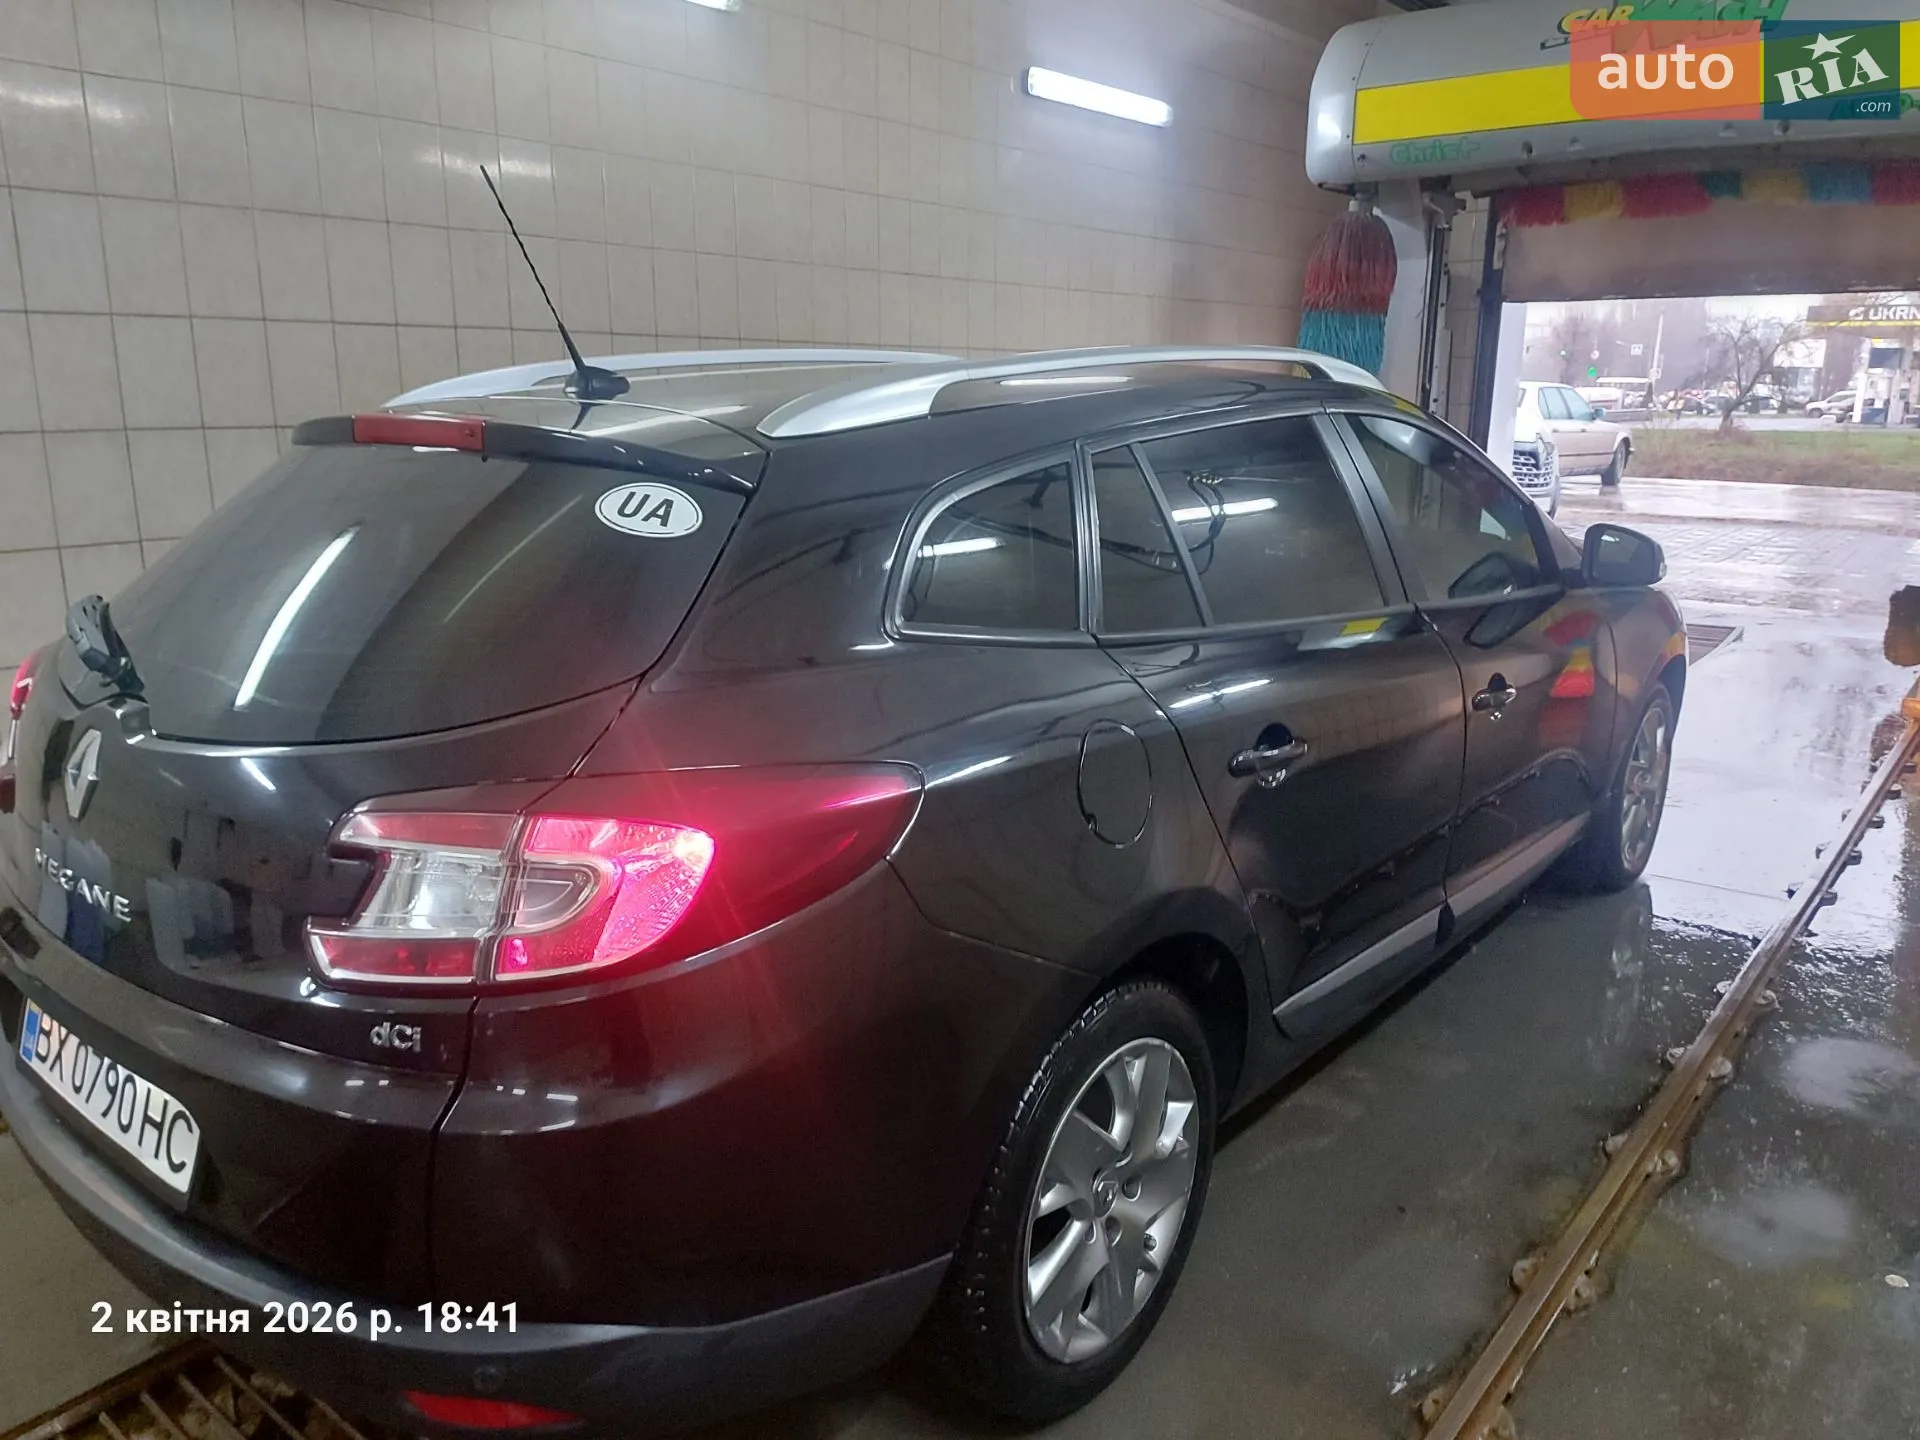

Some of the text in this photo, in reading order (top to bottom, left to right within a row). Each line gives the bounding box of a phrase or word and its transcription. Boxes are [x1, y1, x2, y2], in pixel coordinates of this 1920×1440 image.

[1557, 4, 1635, 35] CAR
[617, 491, 675, 527] UA
[34, 847, 132, 922] MEGANE
[370, 1022, 421, 1052] dCi
